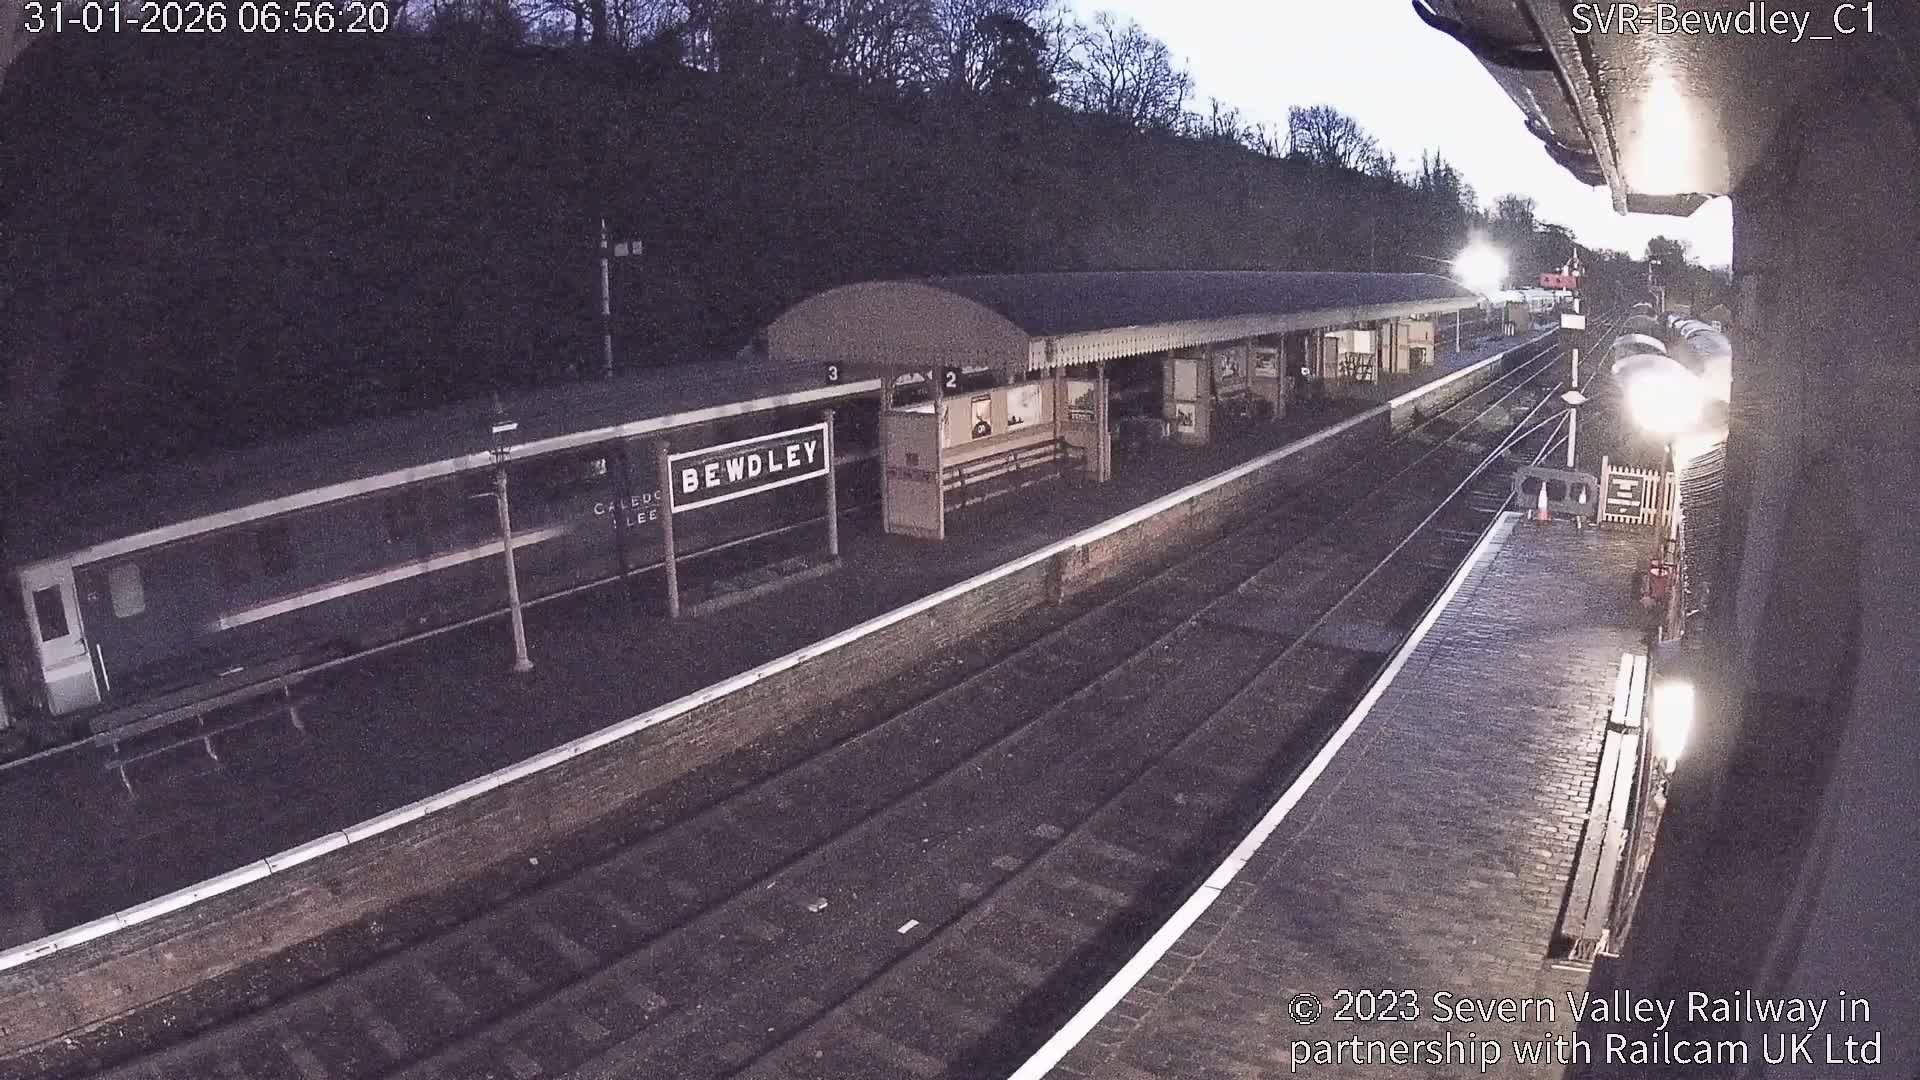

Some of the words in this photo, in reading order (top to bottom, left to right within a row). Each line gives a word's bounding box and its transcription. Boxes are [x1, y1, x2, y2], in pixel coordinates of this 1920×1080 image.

[828, 365, 838, 381] 3
[945, 371, 957, 388] 2
[681, 440, 817, 494] BEWDLEY
